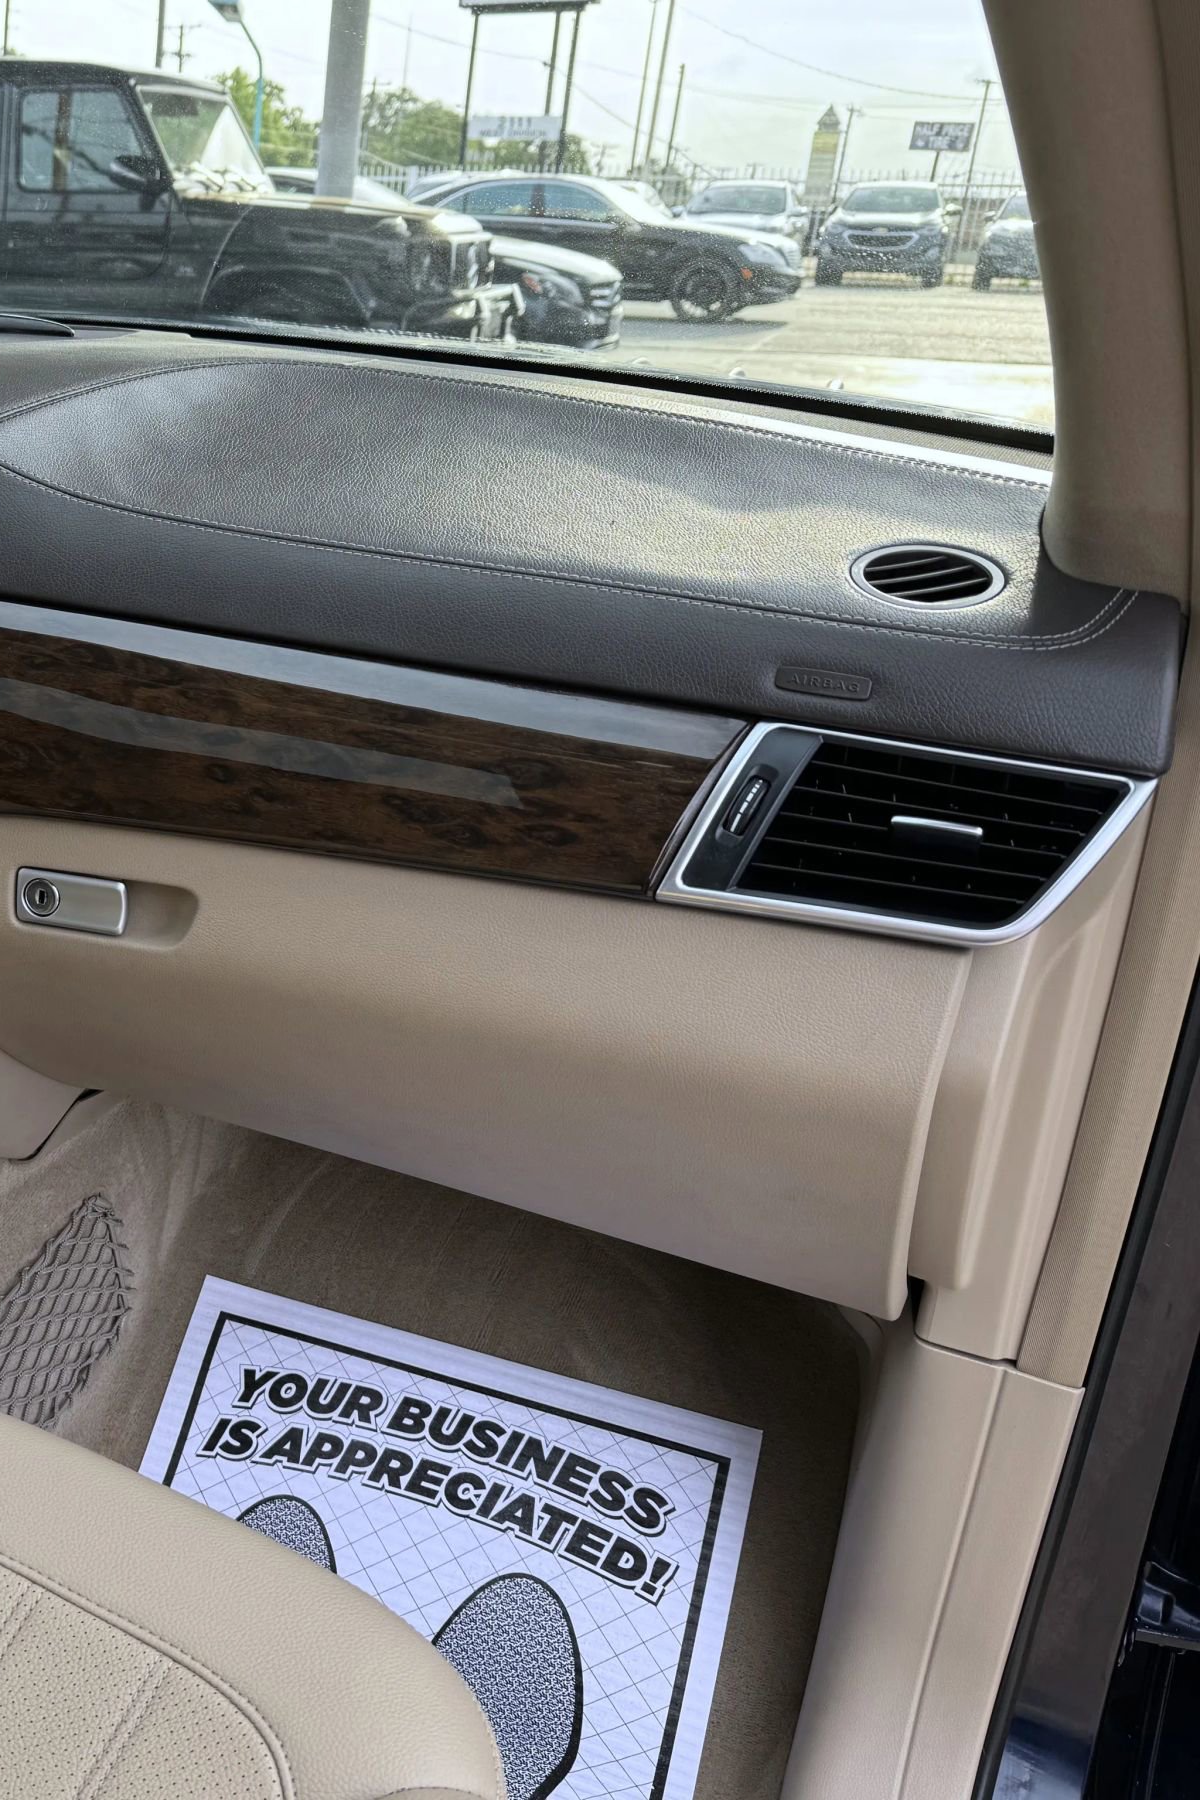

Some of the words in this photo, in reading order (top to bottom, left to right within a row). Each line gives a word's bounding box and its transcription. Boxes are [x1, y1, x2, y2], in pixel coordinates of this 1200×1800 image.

[790, 672, 860, 693] AIRBAG
[197, 1415, 267, 1462] IS
[252, 1426, 679, 1602] APPRECIATED!
[232, 1365, 388, 1430] YOUR
[383, 1392, 676, 1537] BUSINESS
